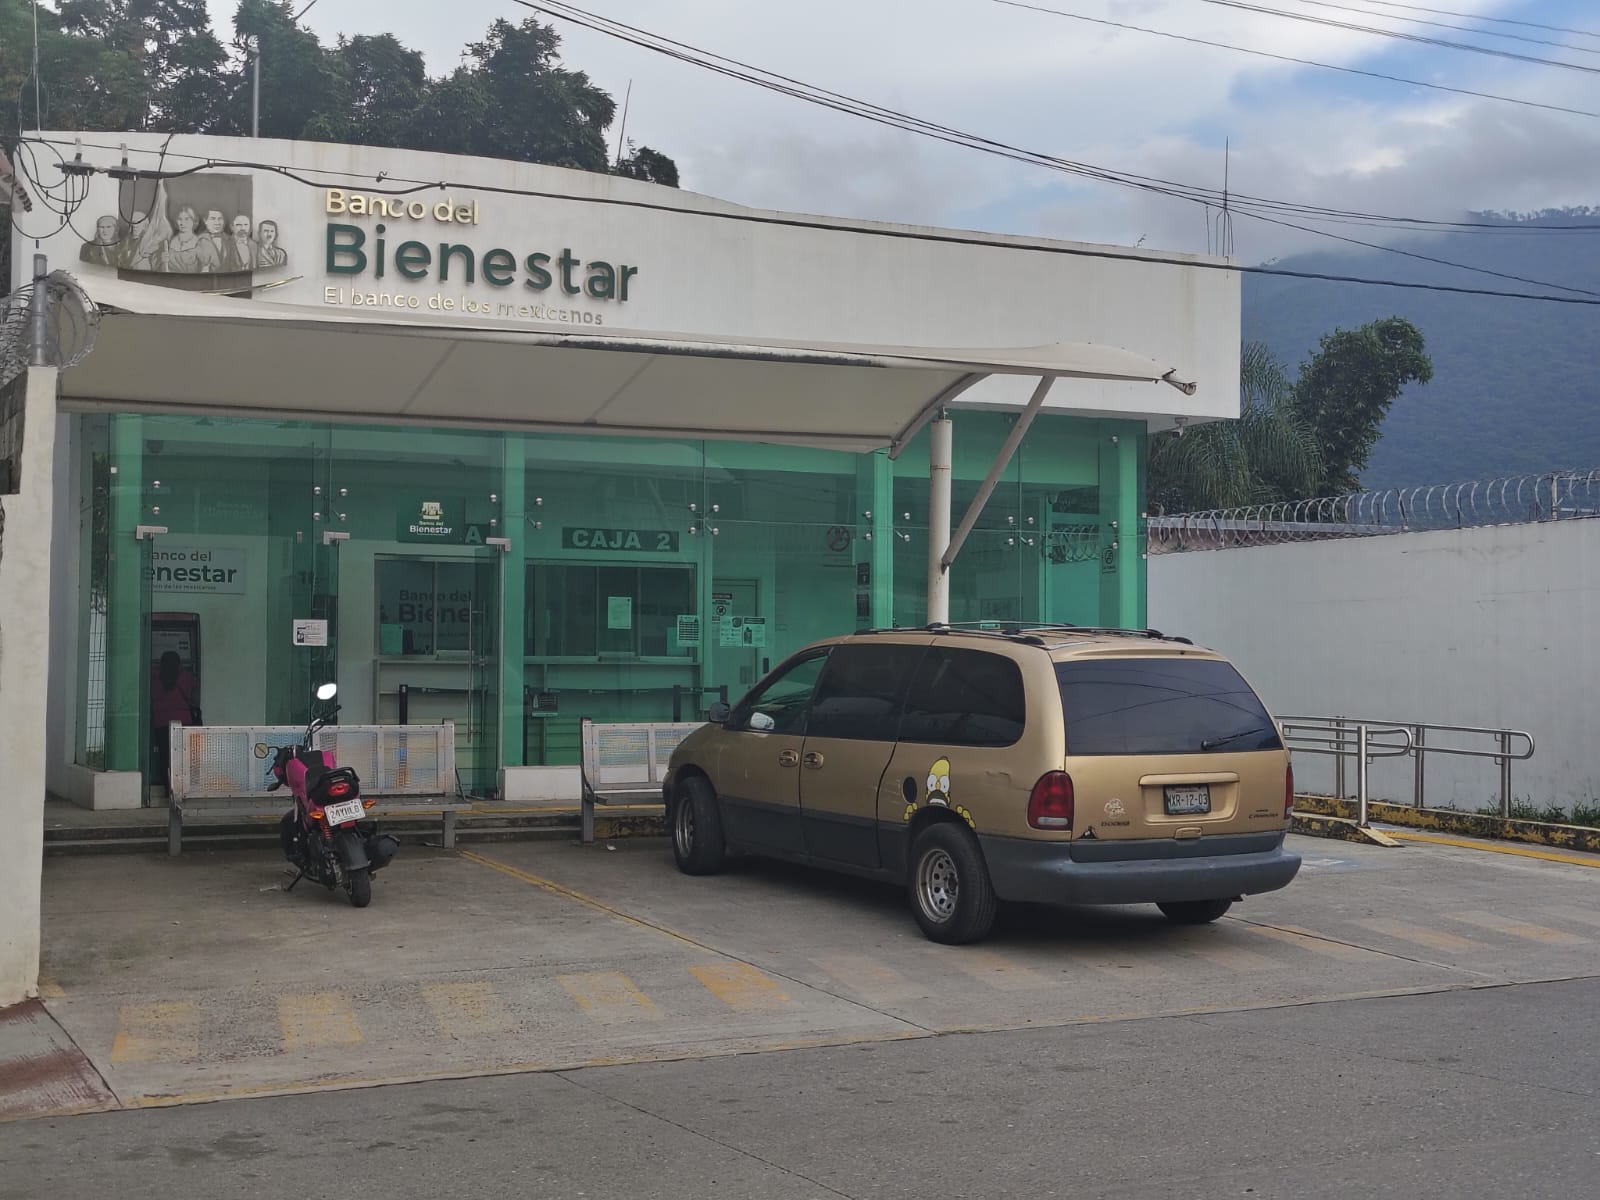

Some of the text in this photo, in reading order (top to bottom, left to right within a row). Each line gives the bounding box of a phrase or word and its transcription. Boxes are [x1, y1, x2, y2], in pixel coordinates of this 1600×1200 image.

[326, 187, 479, 226] Banco del
[326, 222, 638, 303] Bienestar
[324, 286, 603, 326] El banco de los mexicanos
[409, 525, 452, 535] Bienestar
[572, 529, 671, 550] CAJA 2
[190, 550, 212, 562] del
